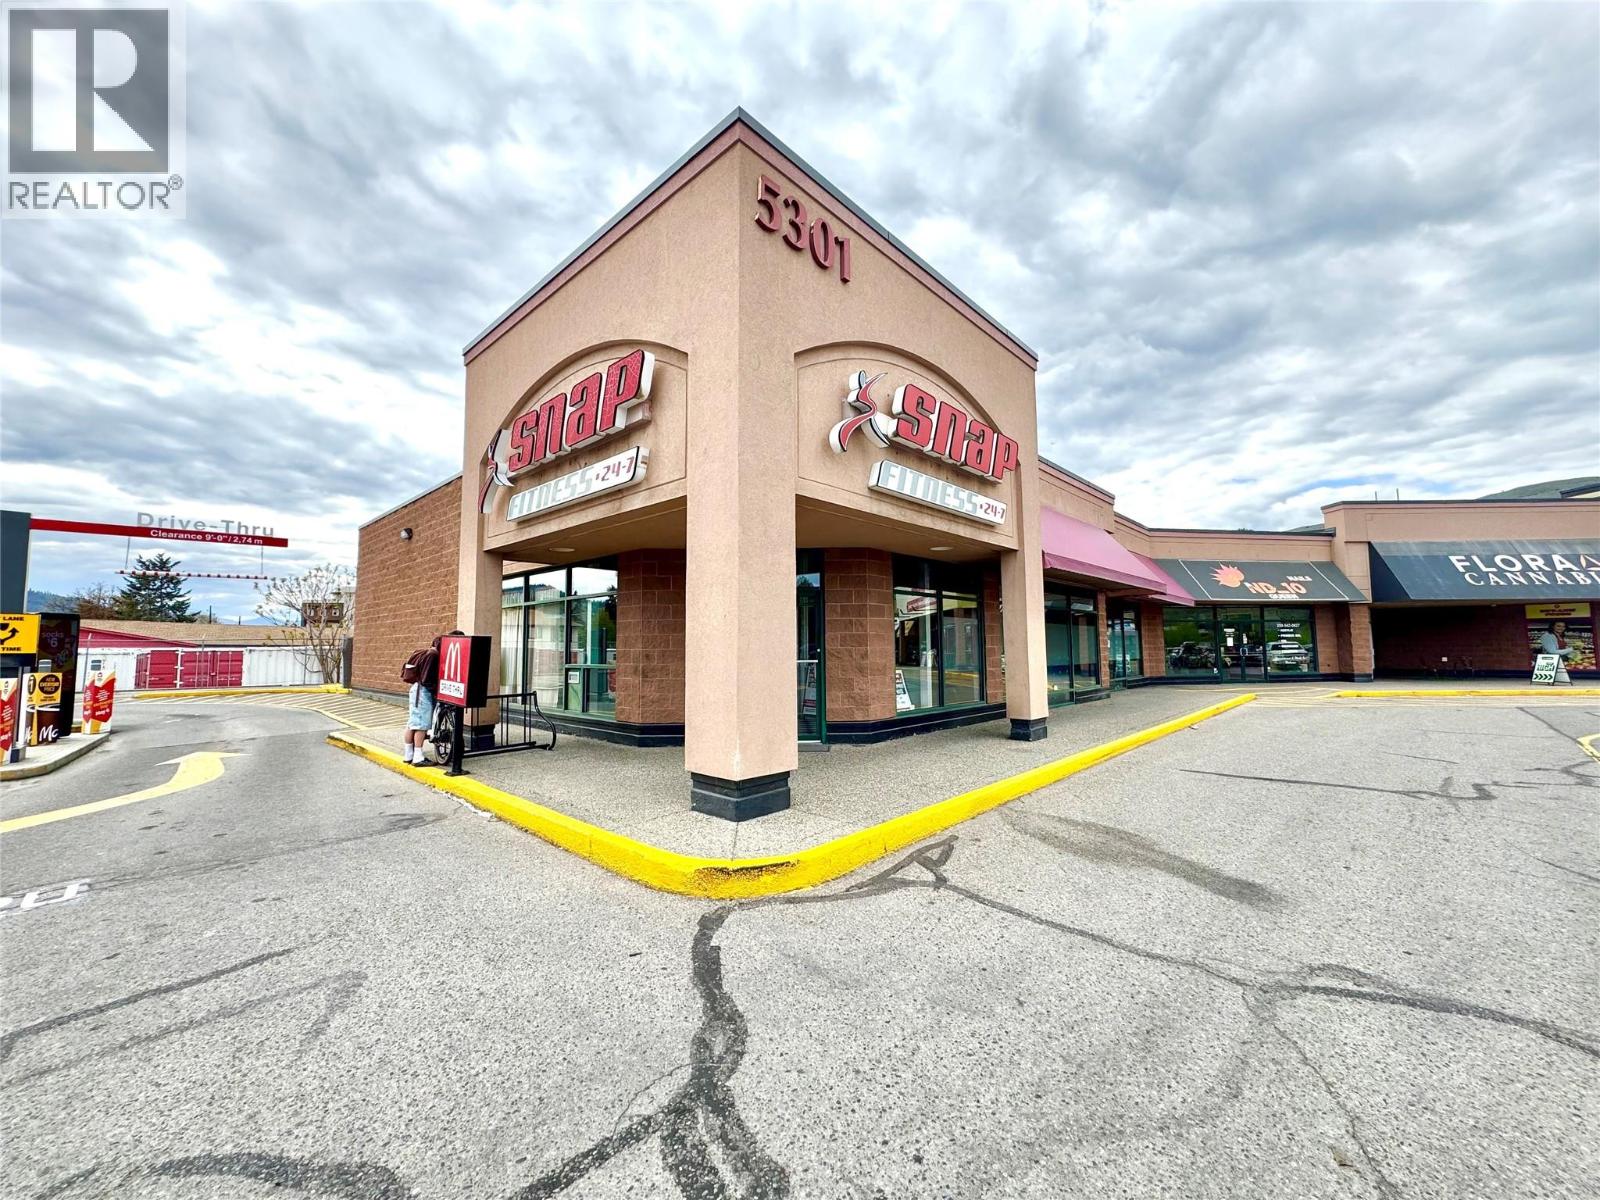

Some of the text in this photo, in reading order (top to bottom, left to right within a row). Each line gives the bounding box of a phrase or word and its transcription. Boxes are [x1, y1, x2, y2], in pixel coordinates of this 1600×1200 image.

[754, 174, 851, 284] 5301
[509, 467, 594, 518] FITNESS
[880, 461, 979, 515] FITNESS
[137, 512, 274, 537] Drive-Thru
[150, 529, 203, 541] Clearance
[1448, 554, 1580, 572] FLORA
[39, 724, 59, 742] Mc
